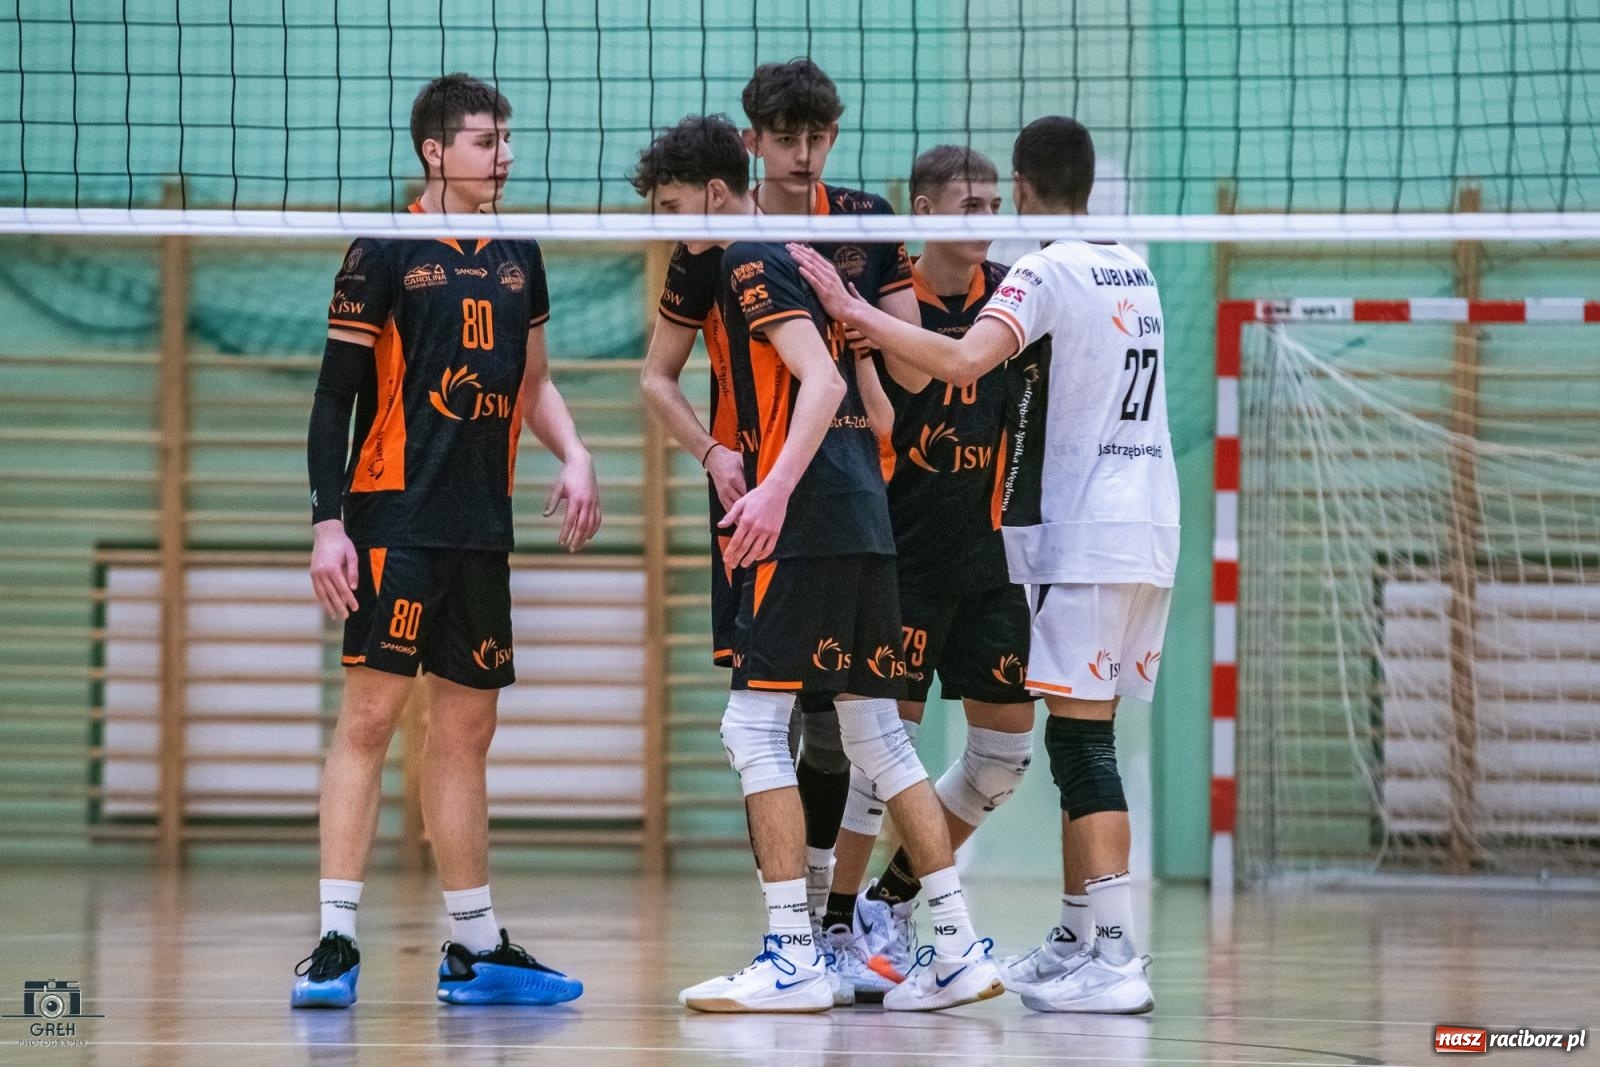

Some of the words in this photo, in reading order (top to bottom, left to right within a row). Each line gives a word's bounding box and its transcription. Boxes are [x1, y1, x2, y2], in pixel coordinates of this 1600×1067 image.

[404, 274, 447, 286] CAROLINA
[461, 298, 494, 350] 80
[1137, 315, 1162, 338] JSW
[1120, 348, 1158, 421] 27
[389, 598, 423, 640] 80
[835, 653, 852, 671] JS
[779, 934, 812, 947] ONS
